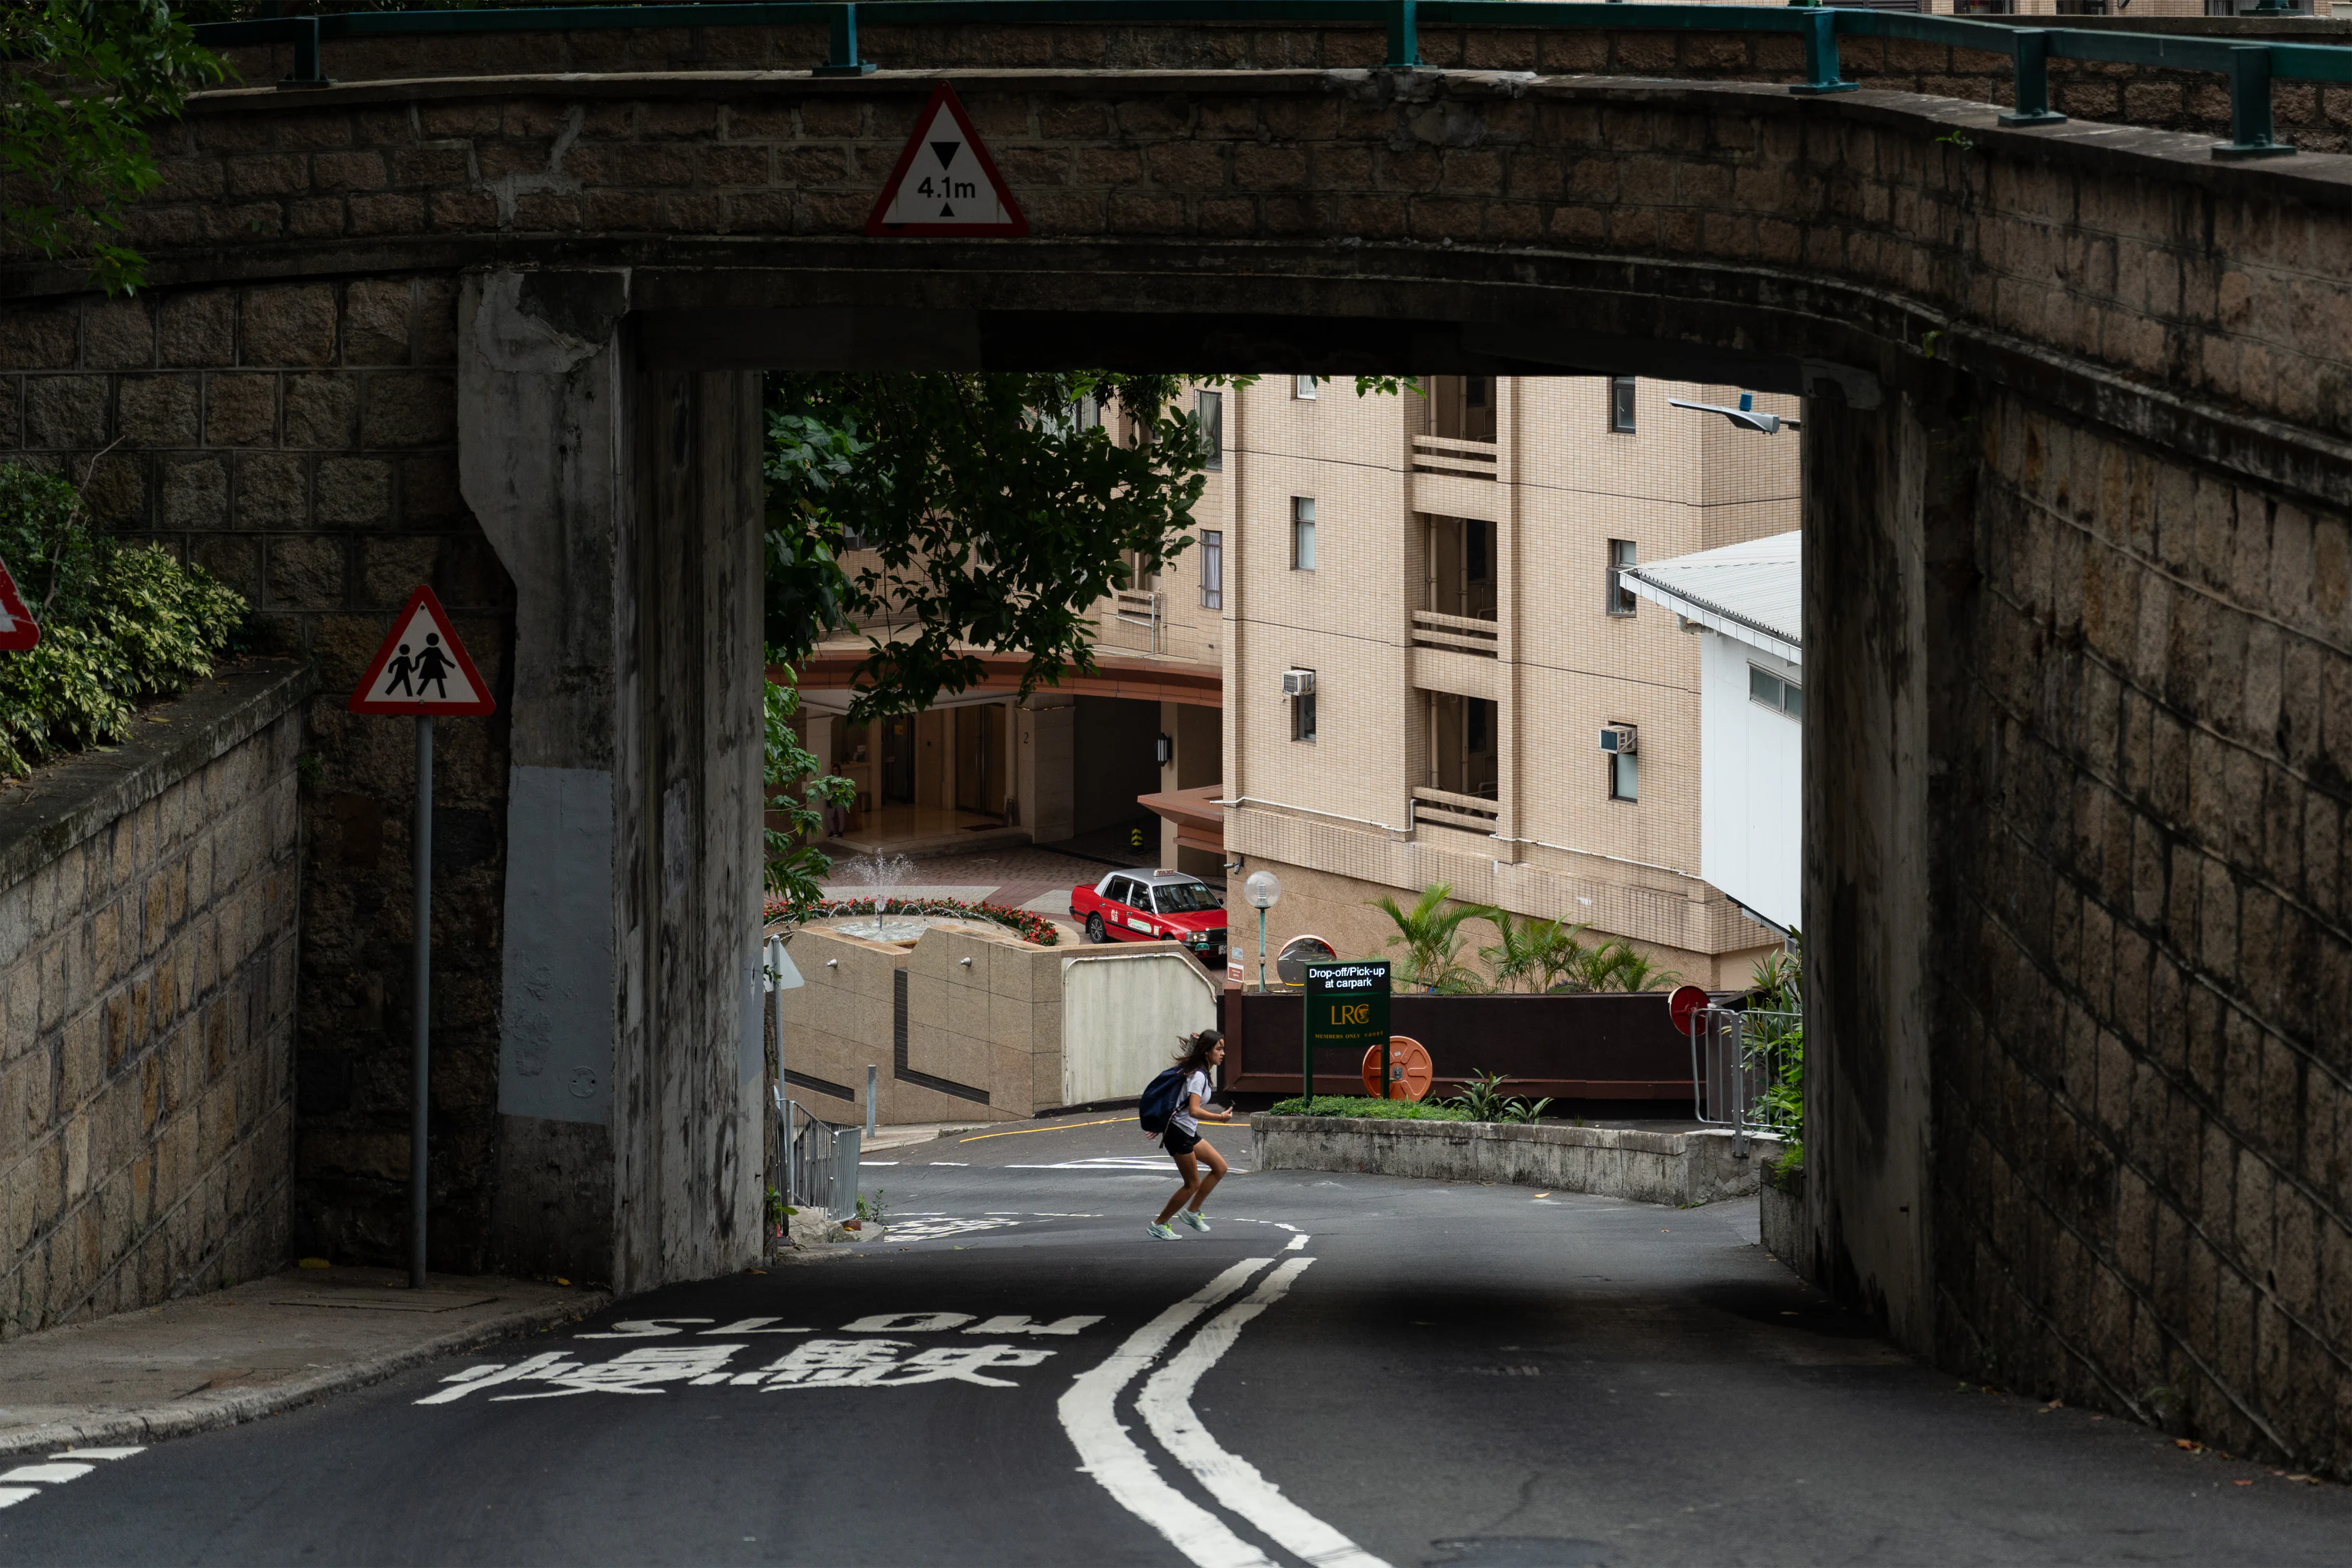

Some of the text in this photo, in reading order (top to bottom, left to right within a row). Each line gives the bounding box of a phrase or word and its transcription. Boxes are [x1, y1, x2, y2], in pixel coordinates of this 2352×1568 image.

[918, 176, 975, 198] 4.1m
[1024, 732, 1029, 744] 2
[1309, 967, 1385, 979] Drop-off/Pick-up
[1325, 978, 1372, 989] at carpark
[1331, 1004, 1369, 1025] LRC
[573, 1311, 1107, 1339] SLOW
[412, 1338, 1058, 1405] 慢駛
